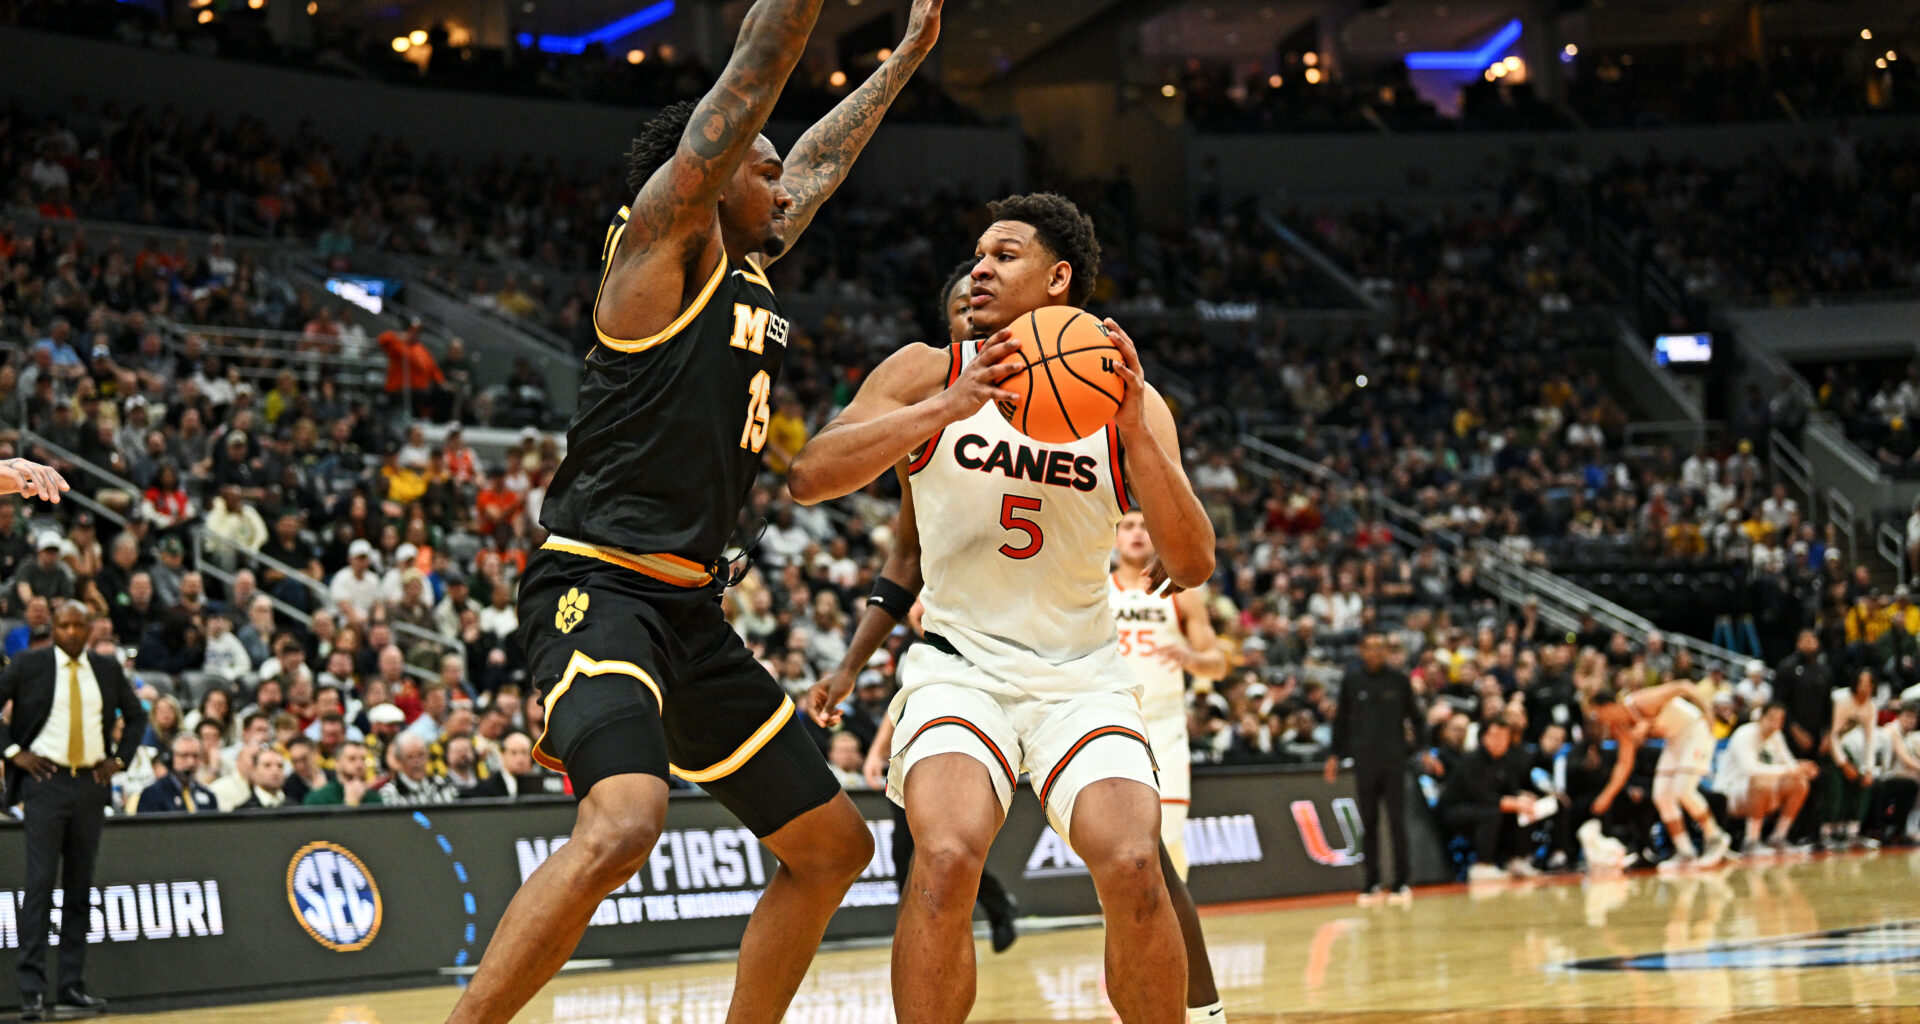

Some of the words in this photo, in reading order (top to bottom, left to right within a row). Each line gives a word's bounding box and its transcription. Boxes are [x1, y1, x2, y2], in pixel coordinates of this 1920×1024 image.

[740, 369, 771, 454] 15
[954, 433, 1098, 492] CANES
[998, 493, 1044, 560] 5
[1114, 608, 1167, 623] ANES
[1117, 629, 1156, 657] 35
[649, 827, 767, 891] FIRST
[294, 850, 375, 943] SEC
